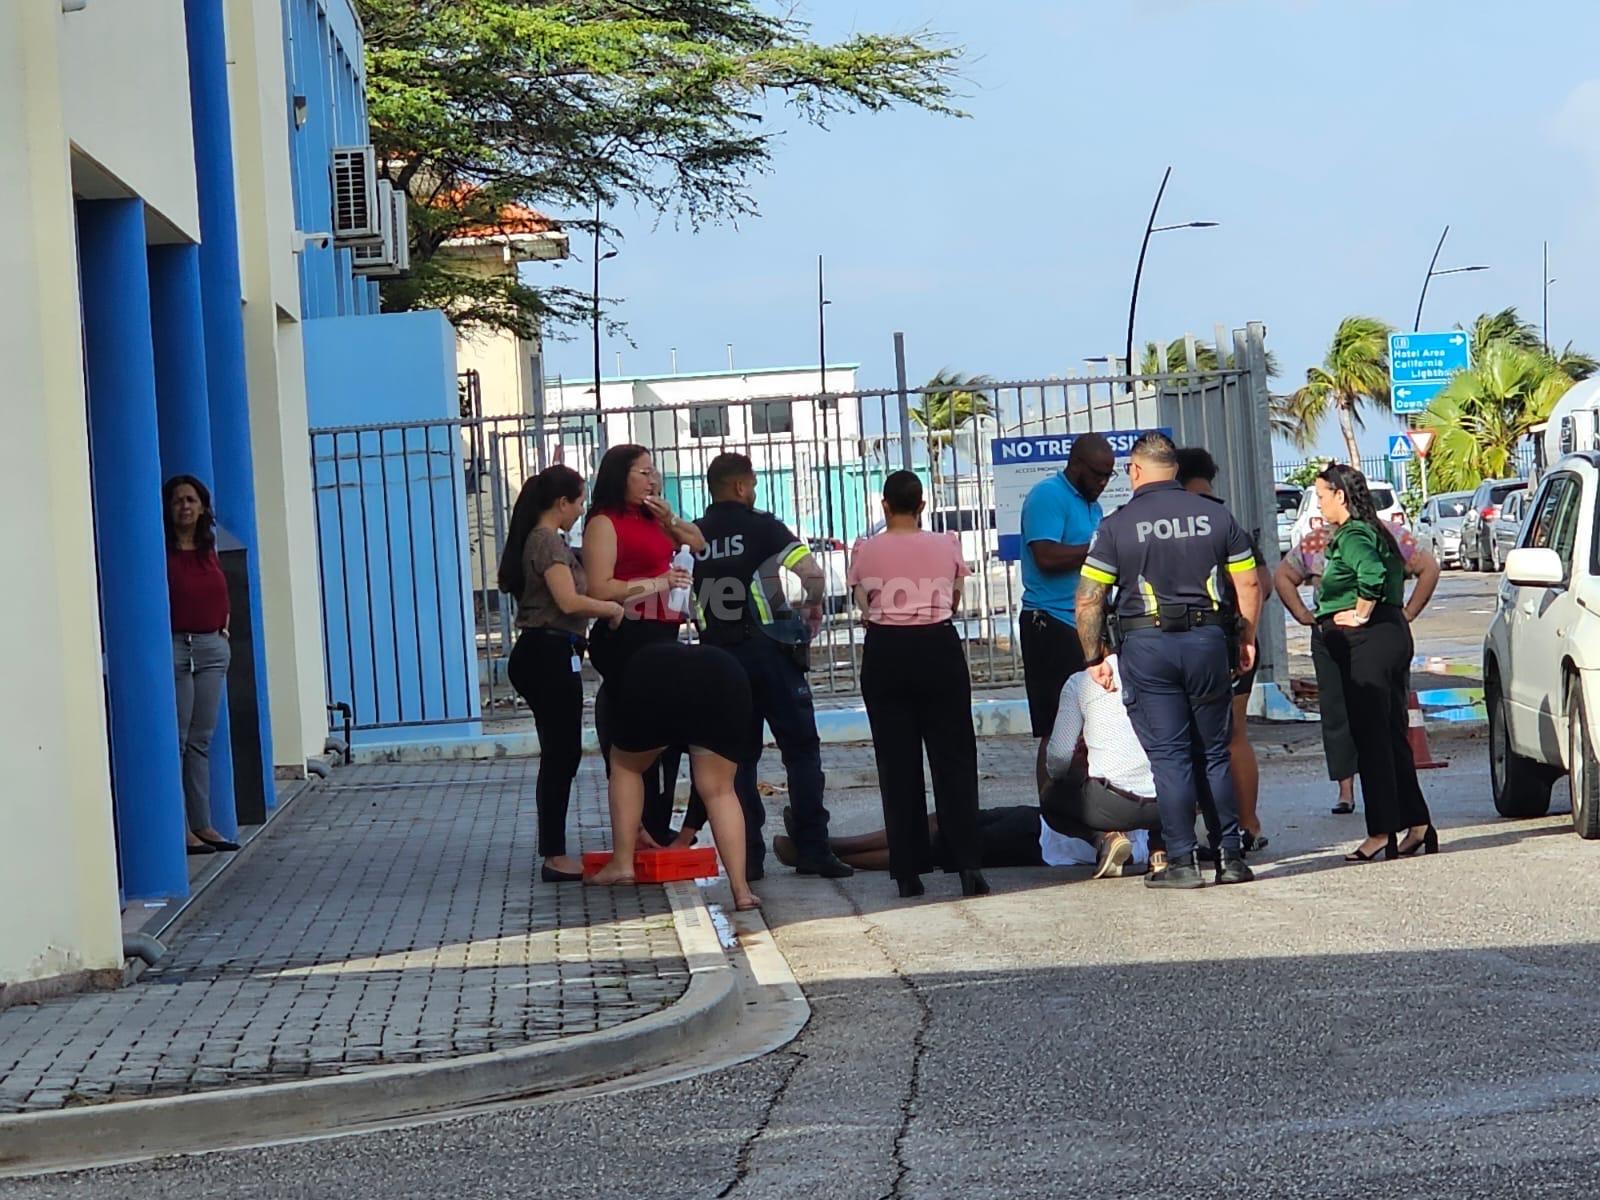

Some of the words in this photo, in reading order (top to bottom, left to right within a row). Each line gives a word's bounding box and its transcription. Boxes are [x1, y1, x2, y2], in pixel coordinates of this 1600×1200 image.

[1423, 349, 1445, 357] Area
[1394, 359, 1444, 368] California
[1411, 369, 1458, 379] Lighth
[1002, 443, 1033, 459] NO
[1036, 434, 1139, 456] TRESSI
[1136, 515, 1211, 543] POLIS
[695, 534, 745, 561] OLIS
